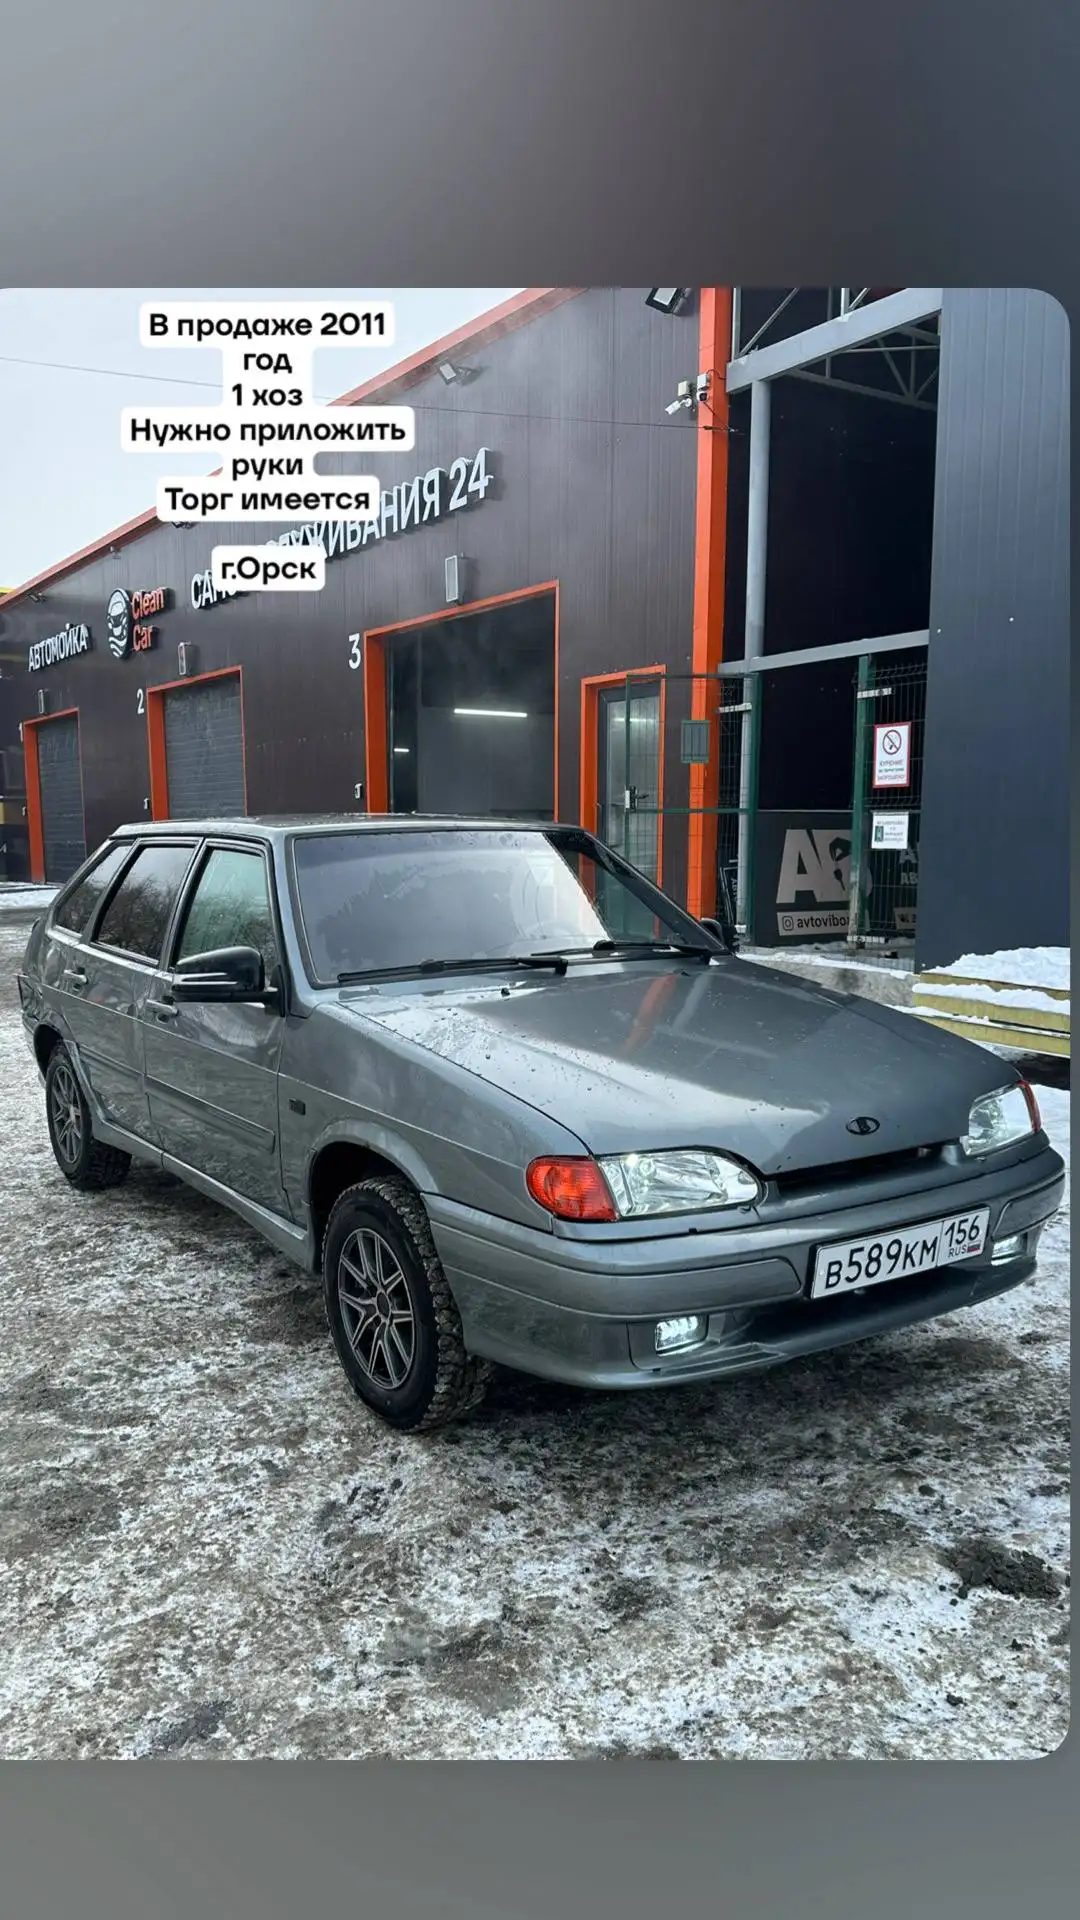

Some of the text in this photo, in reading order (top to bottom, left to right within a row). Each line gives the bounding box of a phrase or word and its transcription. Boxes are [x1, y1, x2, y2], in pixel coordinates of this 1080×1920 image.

[449, 447, 493, 511] 24
[131, 587, 165, 620] Clean
[28, 623, 89, 672] АВТОМОЙКА
[133, 624, 153, 651] Car
[348, 632, 361, 669] 3
[137, 688, 144, 714] 2
[796, 912, 851, 929] avtovibo
[824, 1215, 980, 1290] В589КМ 156
[948, 1244, 968, 1258] RUS
